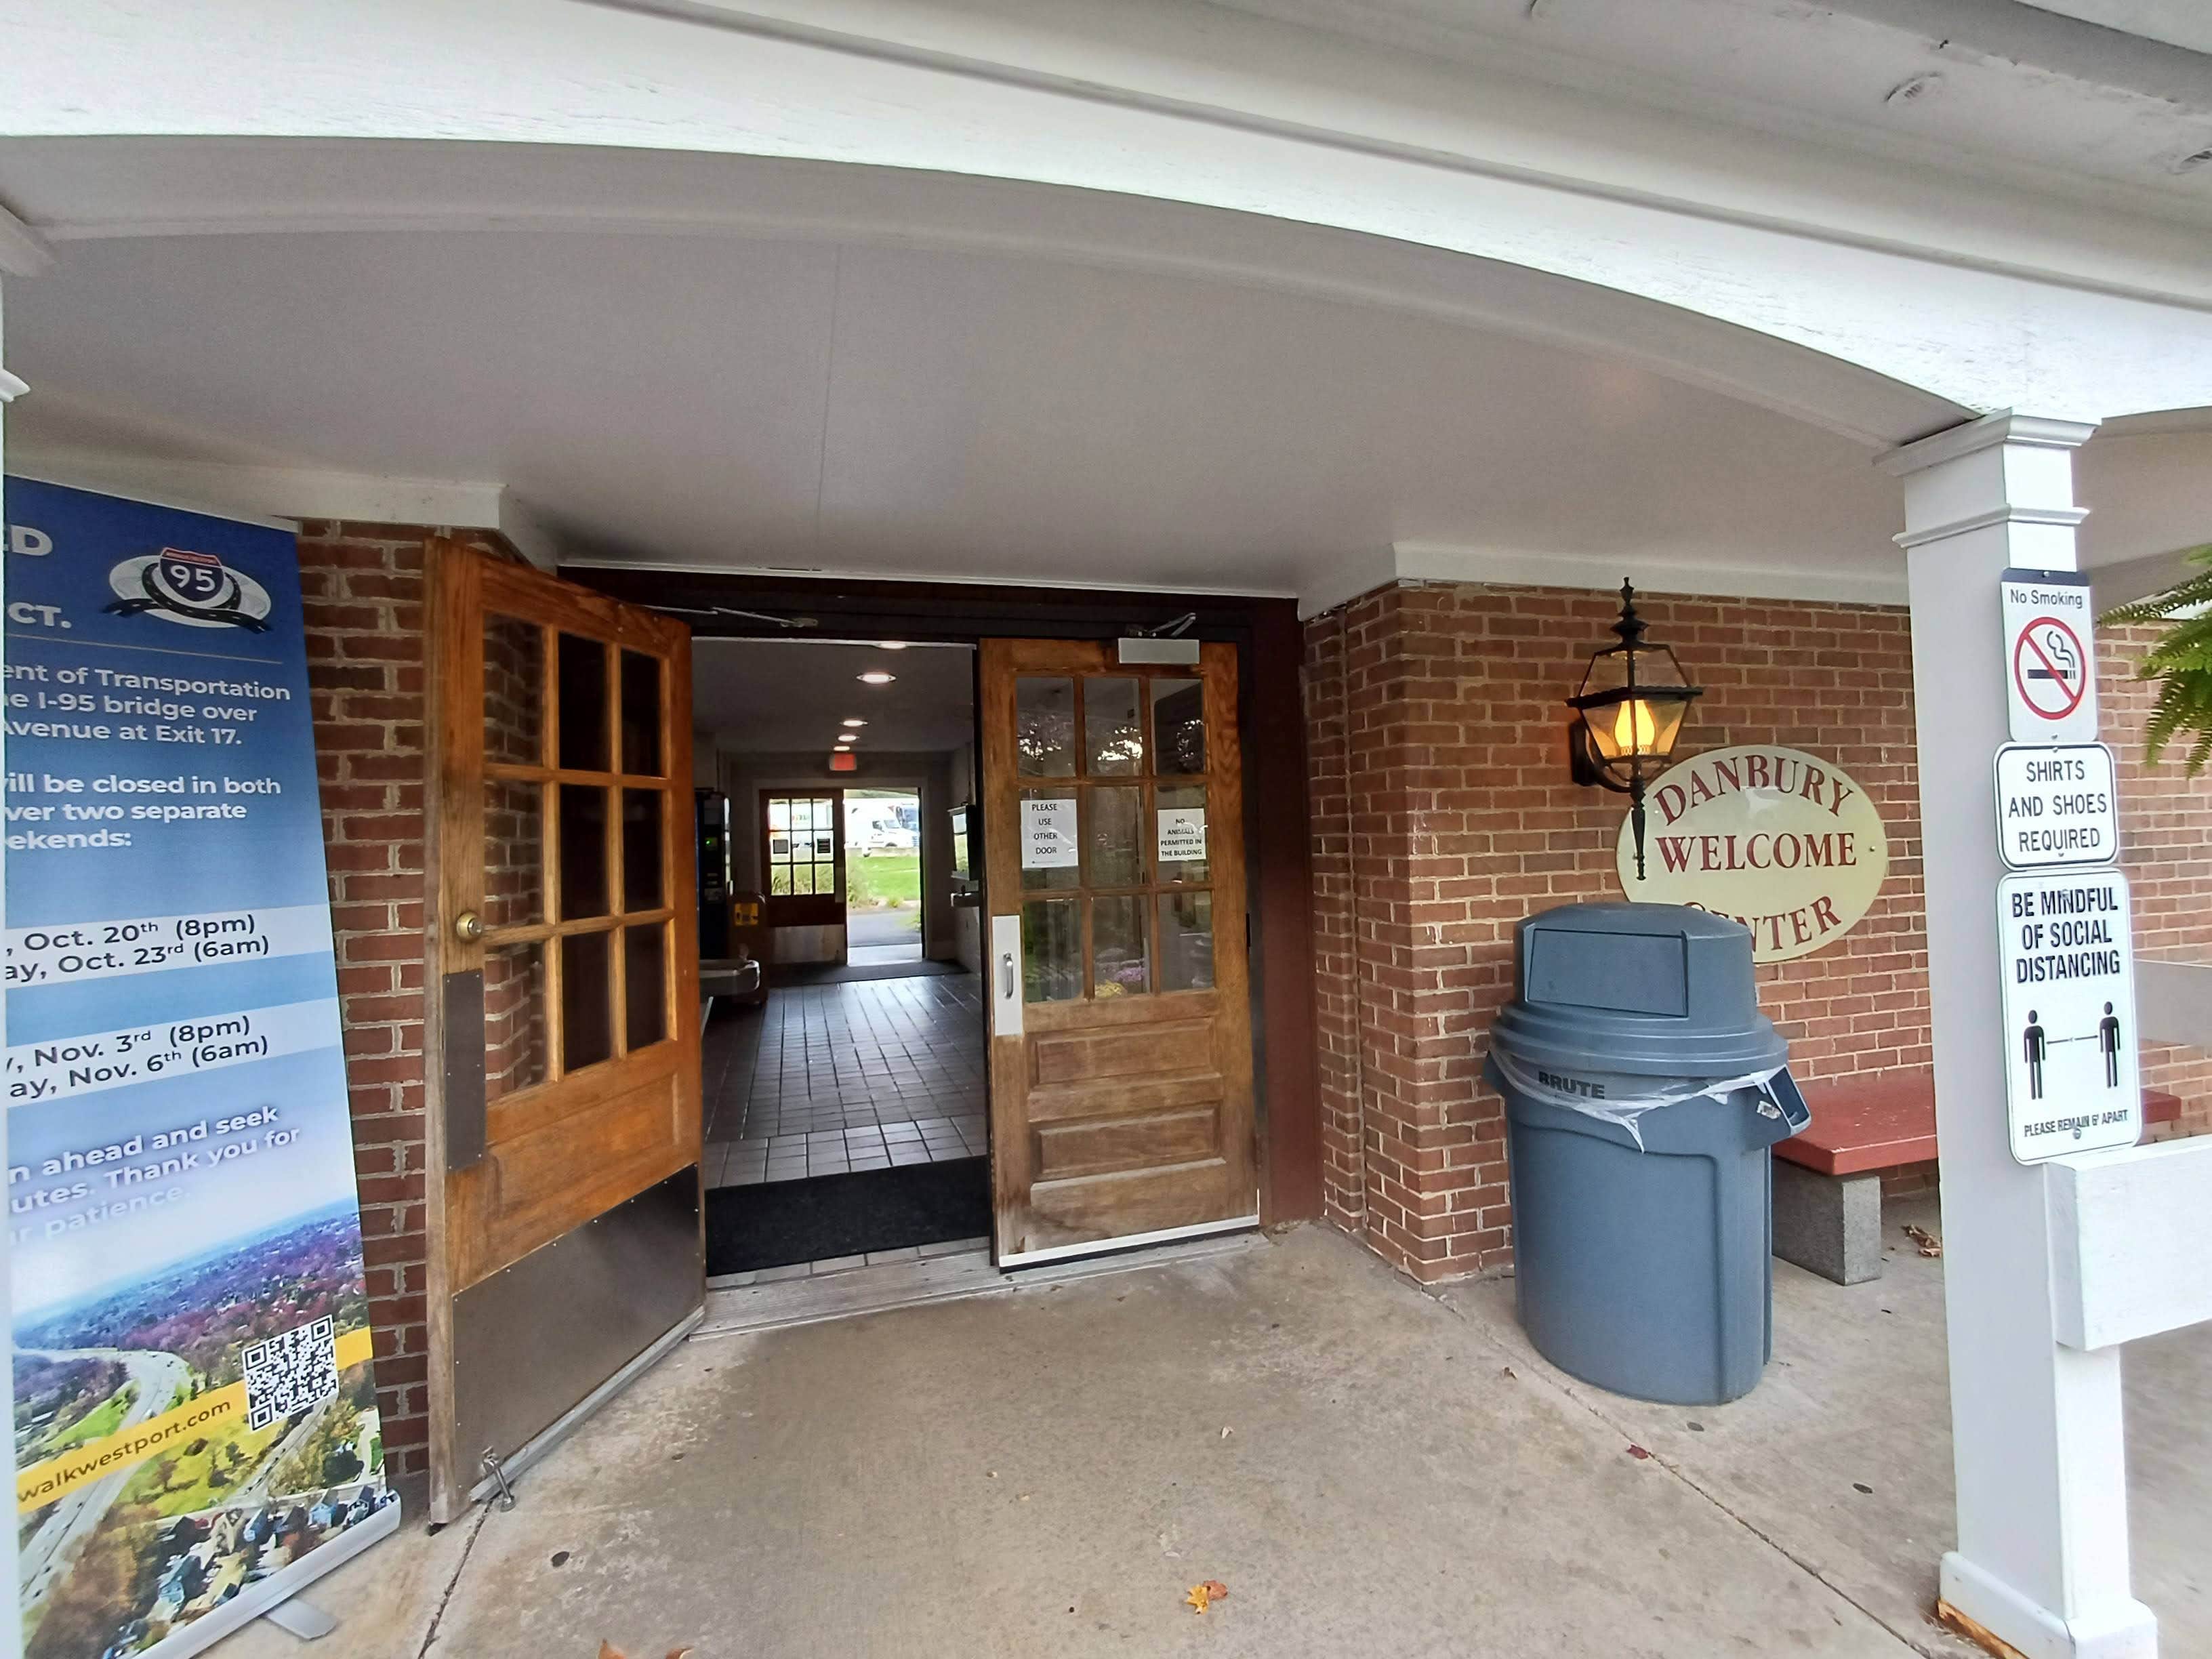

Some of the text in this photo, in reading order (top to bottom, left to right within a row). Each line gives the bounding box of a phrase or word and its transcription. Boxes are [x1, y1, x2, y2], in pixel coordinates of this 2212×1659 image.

[4, 525, 53, 556] D
[171, 565, 215, 592] 95
[2011, 589, 2083, 609] No Smoking
[56, 667, 89, 684] of
[95, 668, 291, 700] Transportation
[38, 692, 96, 712] I-95
[104, 695, 195, 720] bridge
[203, 706, 258, 722] over
[119, 724, 148, 741] at
[155, 724, 205, 743] Exit
[210, 727, 242, 745] 17.
[4, 772, 282, 794] ill be closed in both
[2026, 760, 2085, 783] SHIRTS
[1653, 754, 1854, 827] DANBURY
[62, 804, 125, 821] two
[131, 802, 247, 823] separate
[1031, 803, 1058, 811] PLEASE
[2008, 793, 2108, 818] AND SHOES
[5, 828, 132, 850] ekends:
[1033, 832, 1058, 840] OTHER
[1036, 846, 1057, 855] DOOR
[2018, 827, 2100, 852] REQUIRED
[1174, 848, 1203, 857] BUILDING
[1655, 833, 1858, 874] WELCOME
[2011, 887, 2118, 917] BE MINDFUL
[24, 914, 255, 951] Oct. 20th (8pm)
[1683, 896, 1842, 953] NTER
[2022, 920, 2112, 949] OF SOCIAL
[58, 953, 124, 973] Oct.
[134, 943, 184, 965] 23rd
[194, 935, 268, 962] (6am)
[2015, 950, 2121, 983] DISTANCING
[34, 1044, 104, 1067] Nov.
[116, 1030, 152, 1053] 3rd
[170, 1015, 249, 1047] (8pm)
[69, 1063, 137, 1086] Nov.
[146, 1051, 182, 1072] 6th
[192, 1035, 268, 1068] (6am)
[1538, 1071, 1605, 1100] BRUTE
[2024, 1120, 2056, 1137] PLEASE
[2057, 1115, 2090, 1132] REMAIN
[2101, 1109, 2129, 1125] APART
[42, 1135, 143, 1176] ahead
[151, 1120, 208, 1149] and
[216, 1105, 279, 1134] seek
[103, 1151, 200, 1189] Thank
[207, 1139, 258, 1168] you
[264, 1128, 300, 1148] for
[44, 1187, 190, 1240] patience.
[18, 1400, 230, 1502] walkwestport.com
